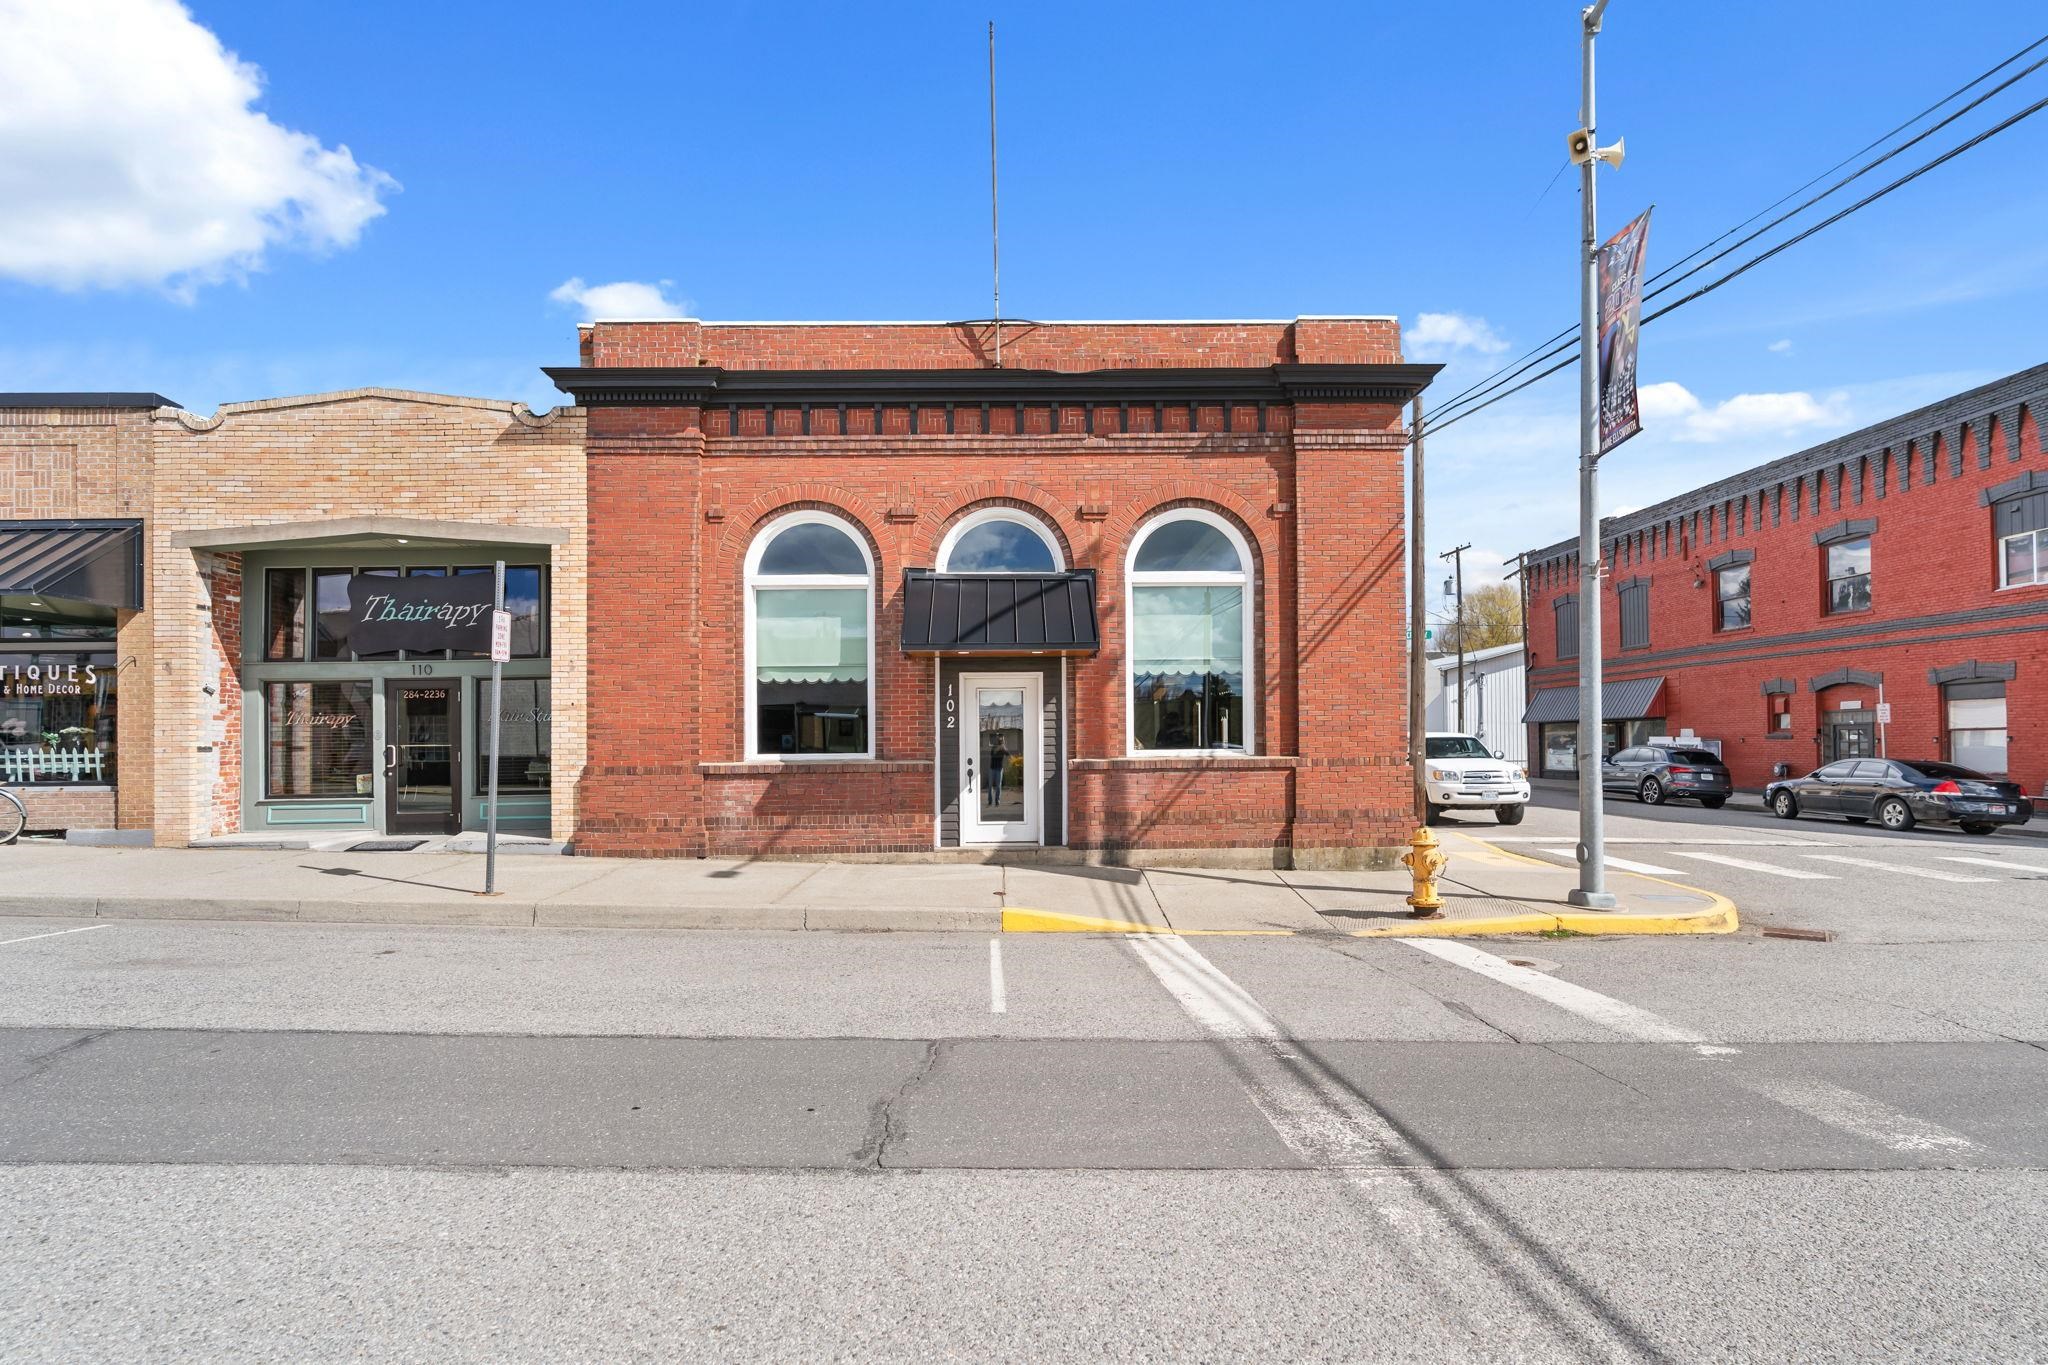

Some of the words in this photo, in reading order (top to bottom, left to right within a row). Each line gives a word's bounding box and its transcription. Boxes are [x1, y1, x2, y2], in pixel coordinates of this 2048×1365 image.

[361, 593, 492, 629] Thairapy
[412, 663, 433, 676] 110
[3, 685, 11, 695] &
[16, 683, 44, 694] HOME
[48, 683, 81, 694] DECOR
[403, 690, 446, 699] 284-2236
[946, 683, 955, 728] 102
